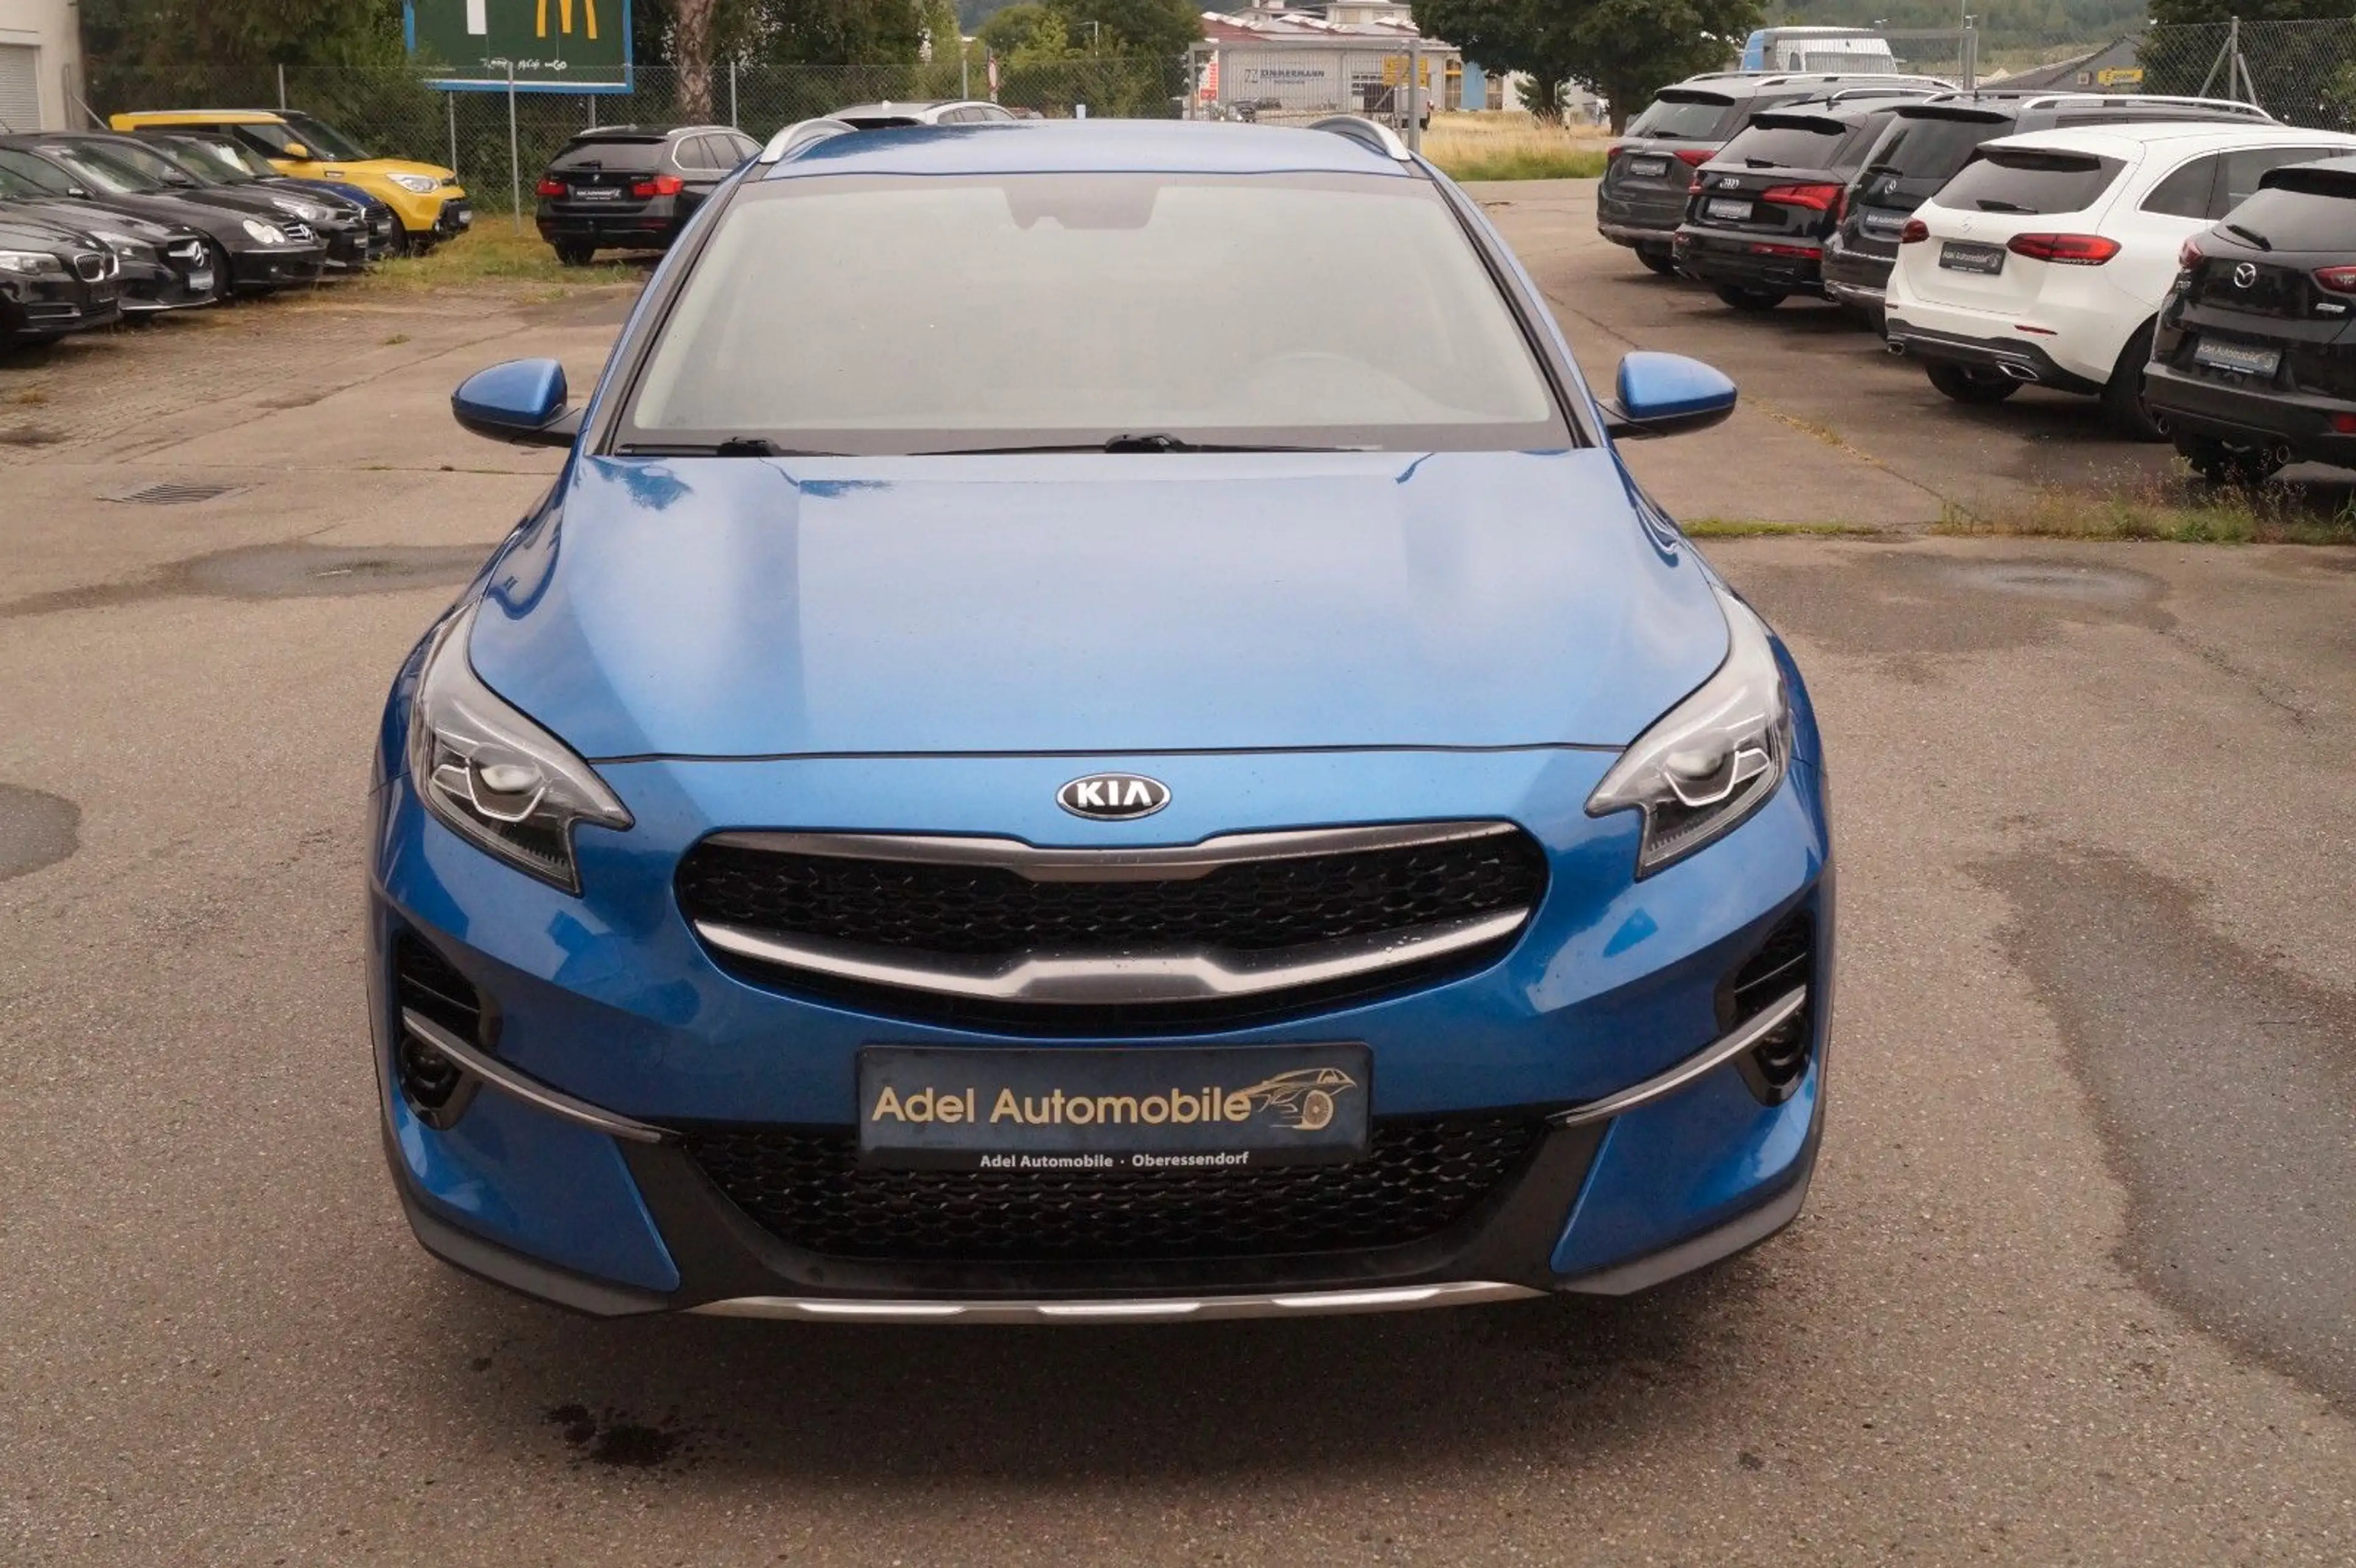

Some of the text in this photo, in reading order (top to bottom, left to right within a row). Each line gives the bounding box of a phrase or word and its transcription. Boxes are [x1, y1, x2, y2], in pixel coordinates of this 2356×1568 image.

[1076, 780, 1153, 807] KIA
[872, 1086, 1251, 1124] Adel Automobile
[980, 1151, 1249, 1167] Adel Automobile Oberessendorf
